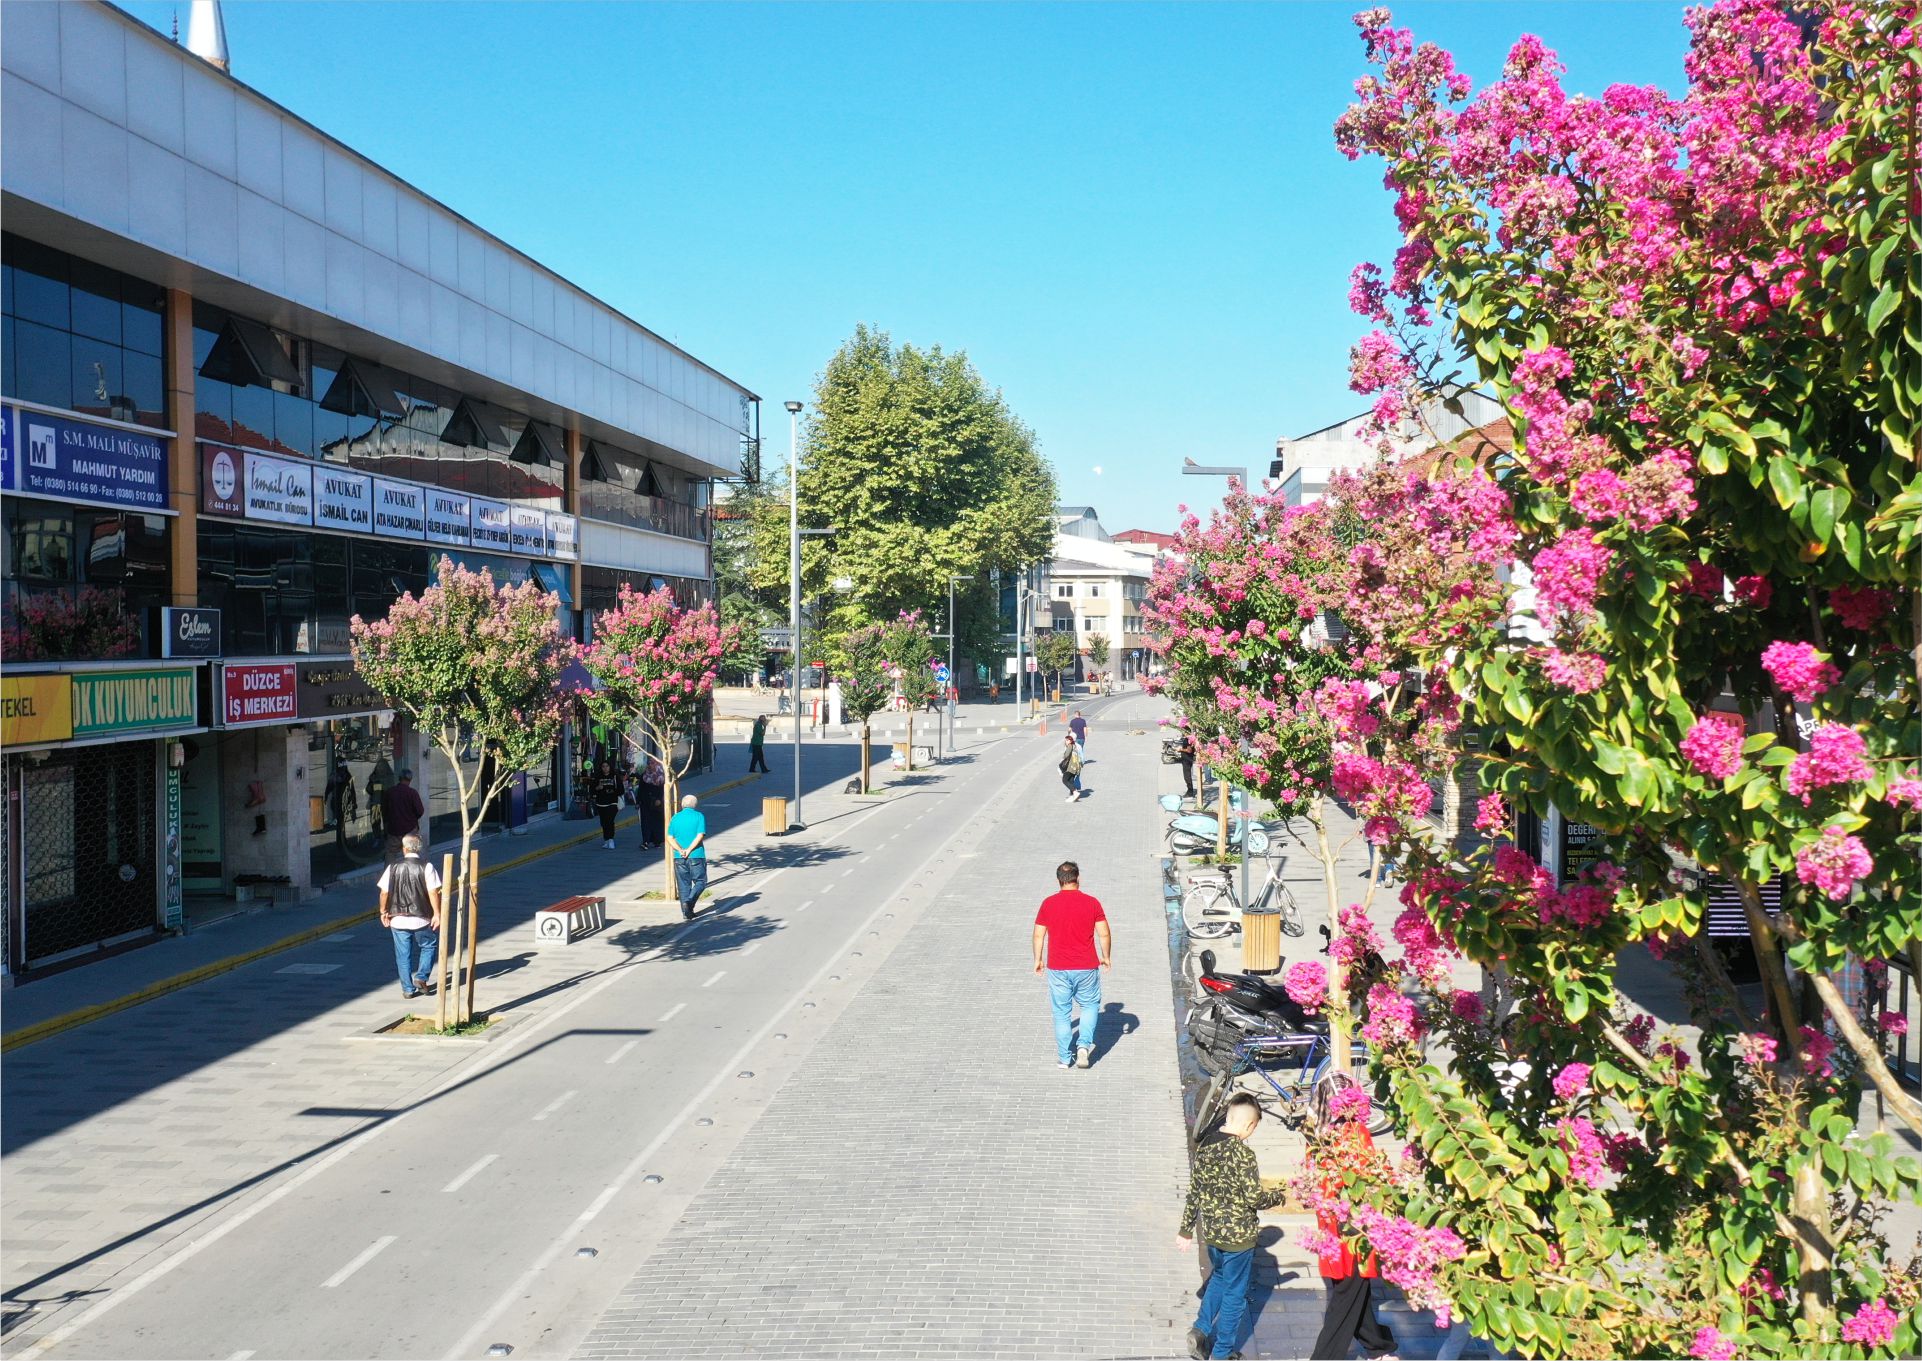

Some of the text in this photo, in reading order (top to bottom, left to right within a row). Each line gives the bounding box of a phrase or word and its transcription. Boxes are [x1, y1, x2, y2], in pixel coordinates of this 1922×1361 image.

[63, 430, 161, 460] S.M. MALİ MÜŞAVİR
[72, 459, 155, 484] MAHMUT YARDIM
[30, 474, 43, 487] Tel:
[67, 480, 79, 492] 514
[80, 482, 89, 494] 66
[89, 484, 98, 494] 90
[324, 478, 363, 500] AVUKAT
[250, 498, 308, 516] AVUKATLIK BÜROSU
[383, 489, 416, 509] AVUKAT
[434, 498, 464, 516] AVUKAT
[319, 500, 369, 525] İSMAİL CAN
[180, 612, 211, 640] Eslem
[243, 669, 281, 691] DÜZCE
[94, 676, 192, 725] KUYUMCULUK
[230, 691, 293, 720] İŞ MERKEZİ
